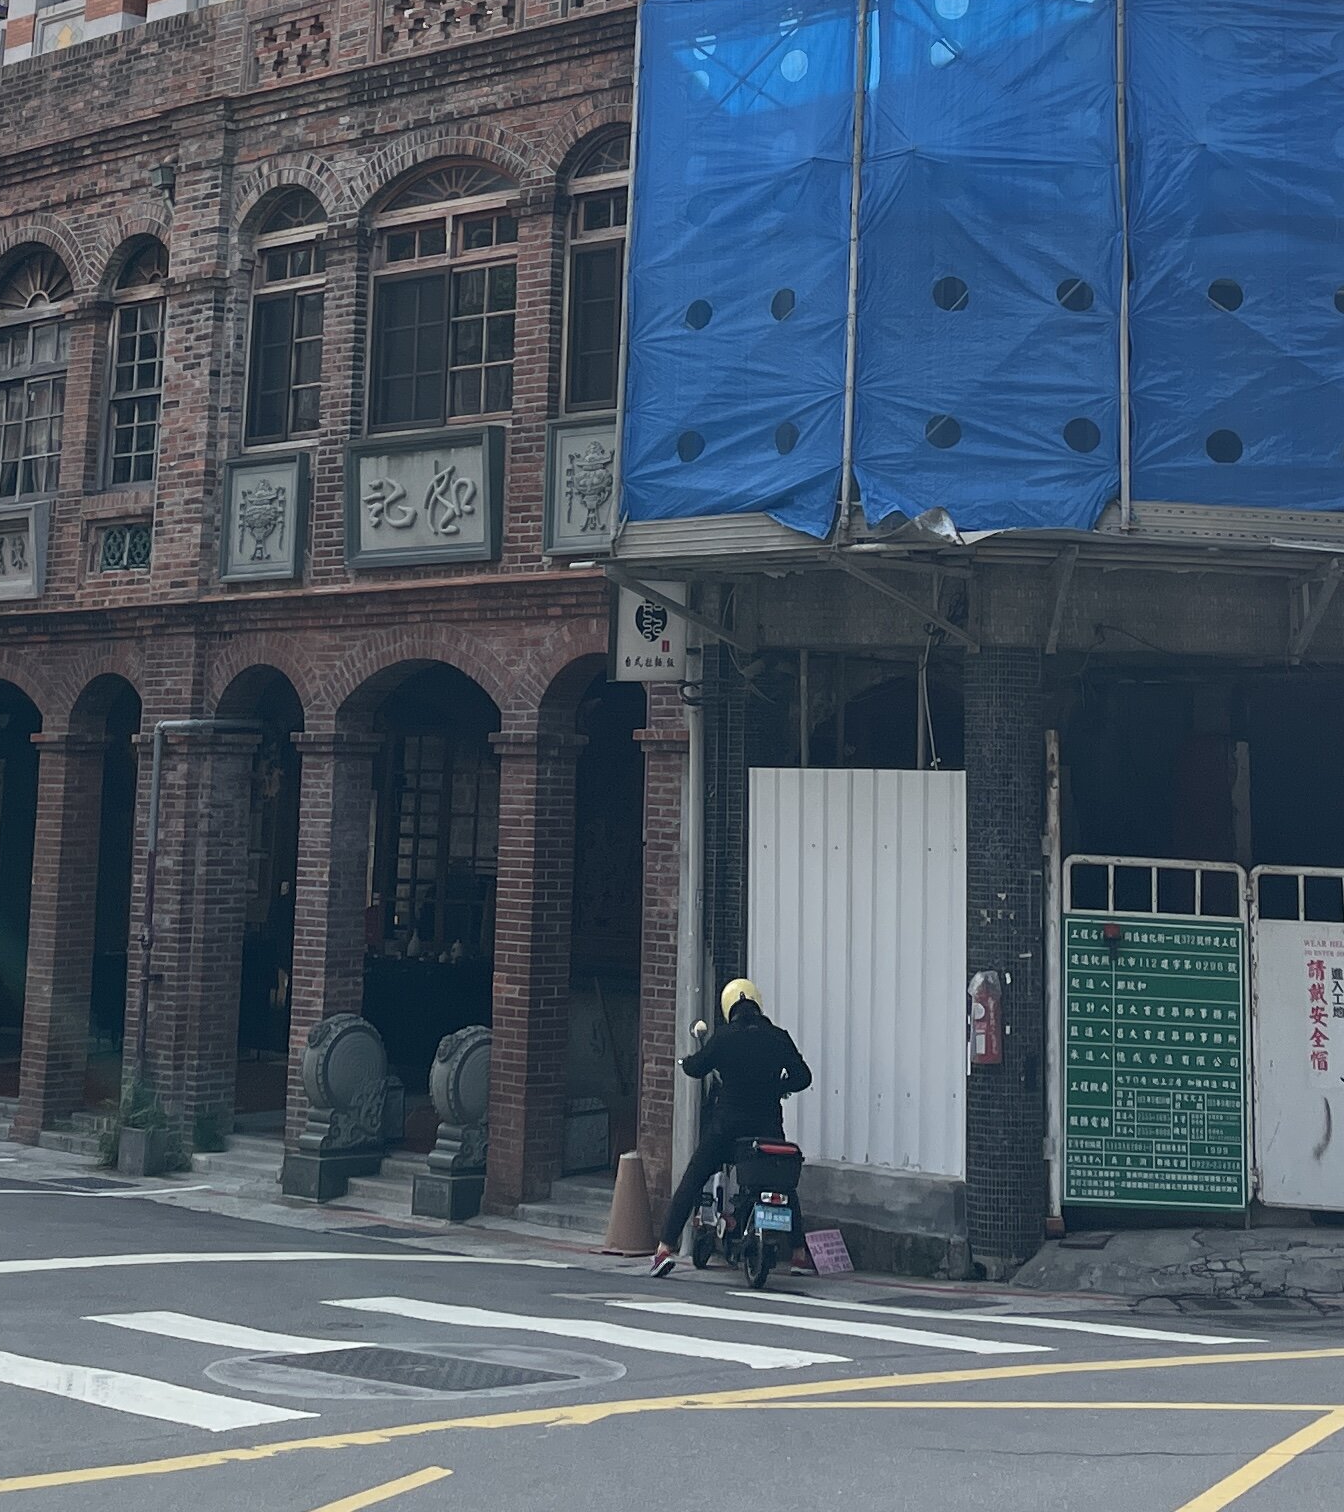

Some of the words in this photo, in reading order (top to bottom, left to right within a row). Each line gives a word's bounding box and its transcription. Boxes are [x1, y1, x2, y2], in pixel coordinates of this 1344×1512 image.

[1306, 959, 1330, 1072] 請戴安全帽
[1331, 967, 1344, 1018] 進入工地
